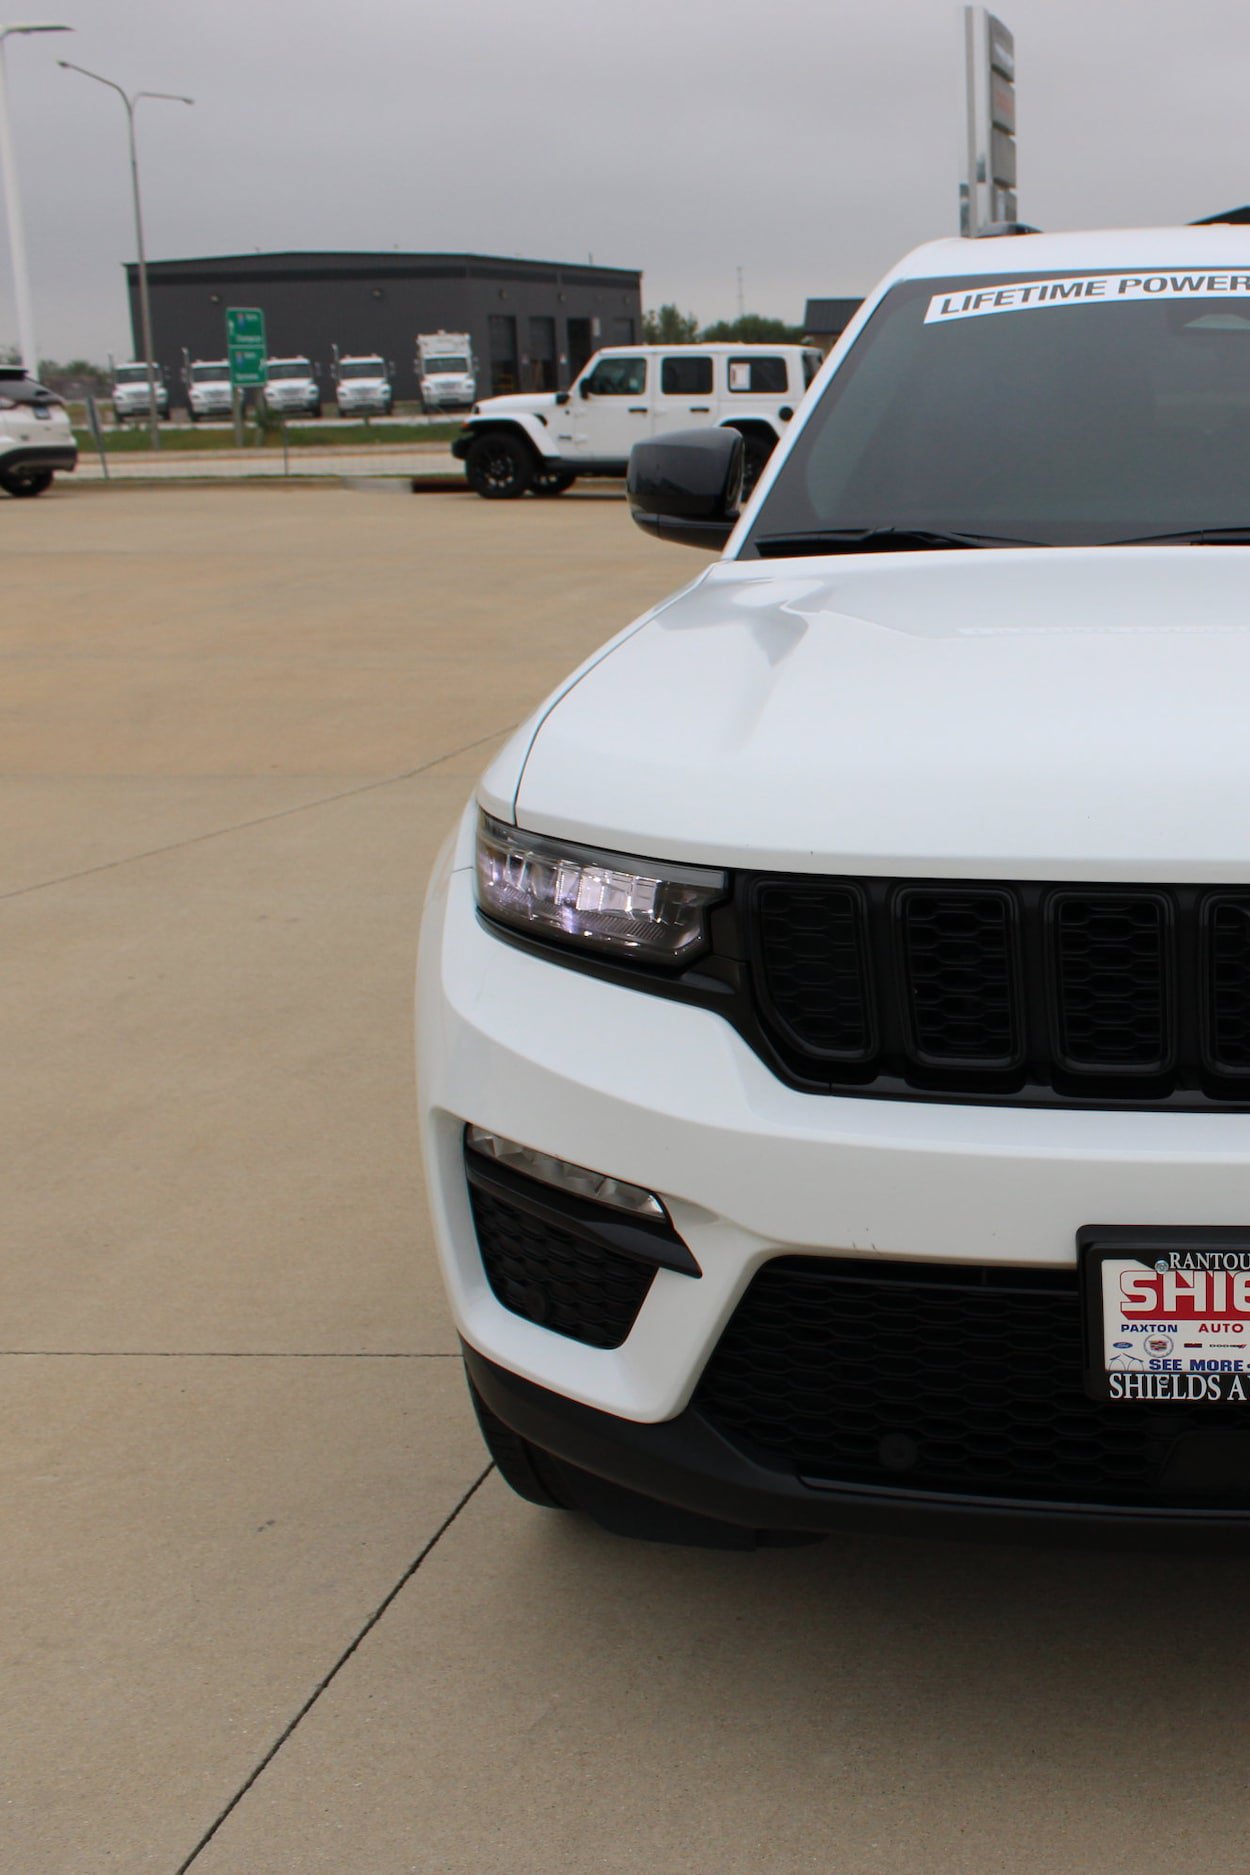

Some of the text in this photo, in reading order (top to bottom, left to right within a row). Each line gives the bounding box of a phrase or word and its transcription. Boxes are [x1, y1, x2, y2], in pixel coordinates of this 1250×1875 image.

[940, 280, 1107, 315] LIFETIME
[1121, 1324, 1178, 1333] PAXTON
[1199, 1323, 1244, 1333] AUTO
[1149, 1359, 1183, 1371] SEE
[1190, 1359, 1244, 1372] MORE
[1109, 1373, 1221, 1400] SHIELDS
